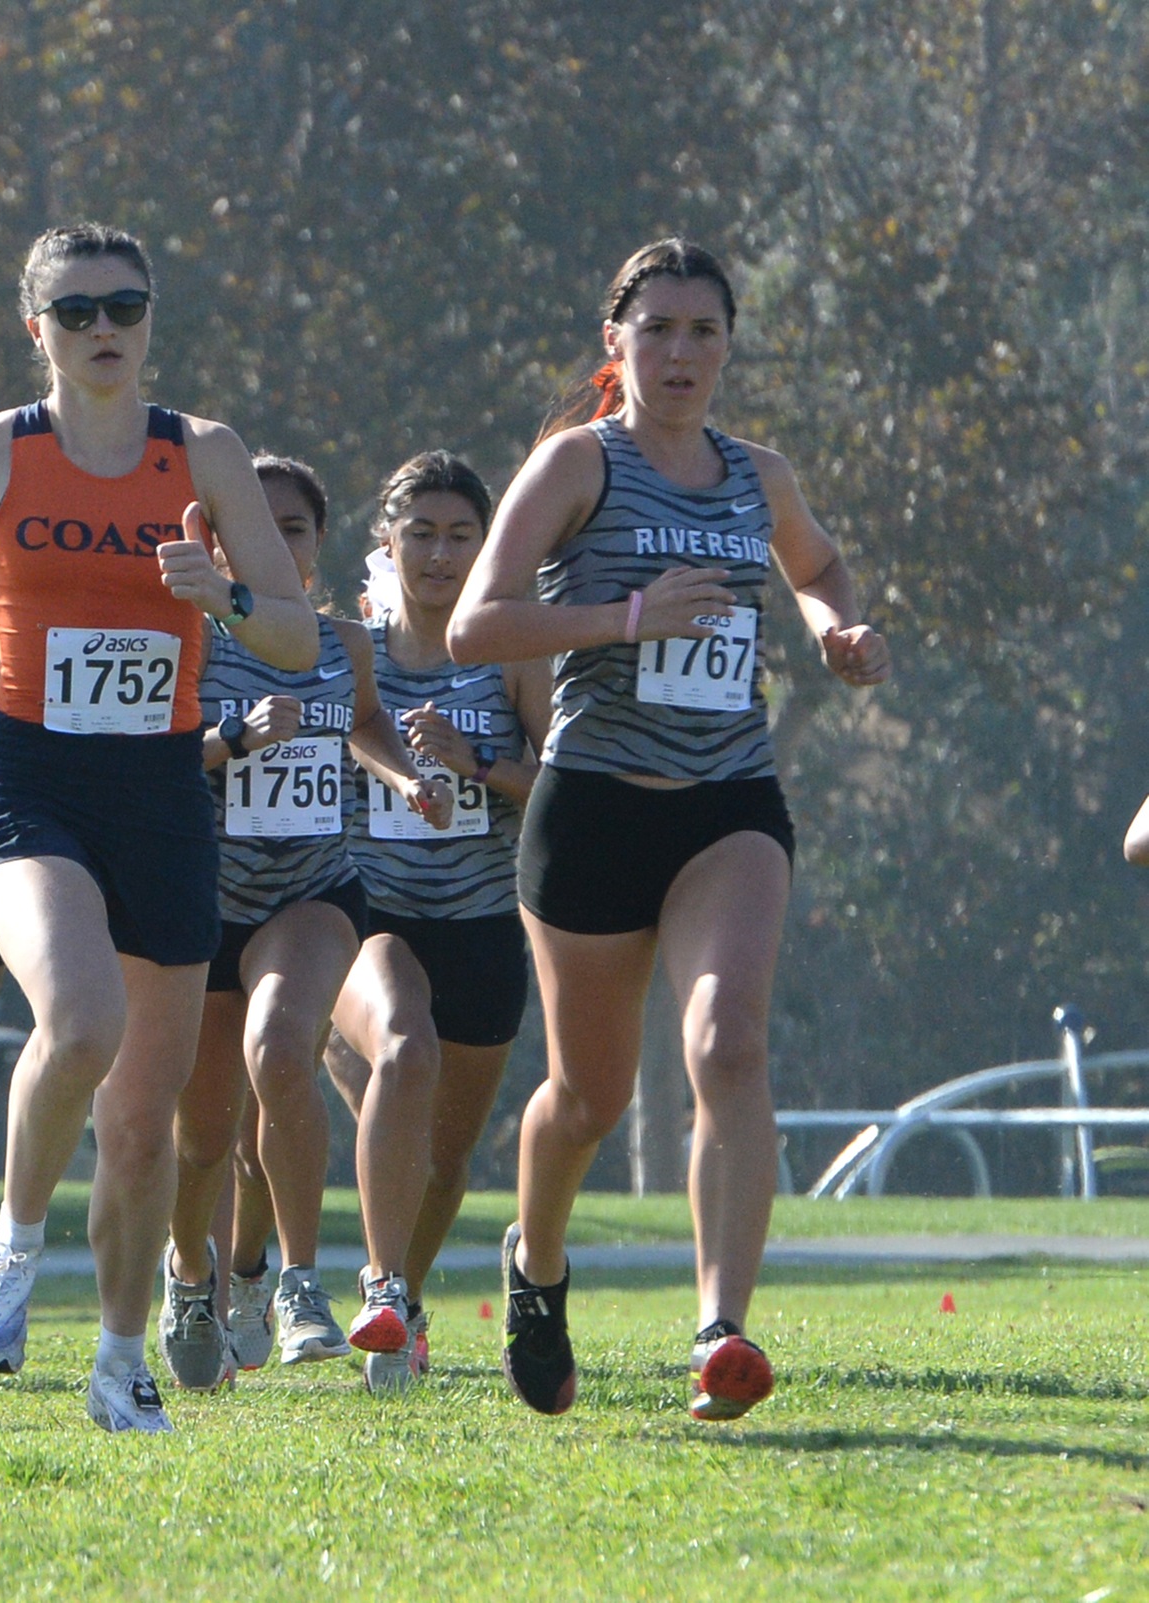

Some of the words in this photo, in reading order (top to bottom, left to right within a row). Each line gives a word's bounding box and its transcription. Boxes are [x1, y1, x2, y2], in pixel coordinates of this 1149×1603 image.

[105, 637, 148, 652] asics
[654, 634, 751, 681] 1767
[53, 657, 174, 705] 1752
[281, 745, 317, 759] asics
[416, 753, 445, 767] asic
[234, 764, 338, 808] 1756
[375, 773, 483, 810] 15
